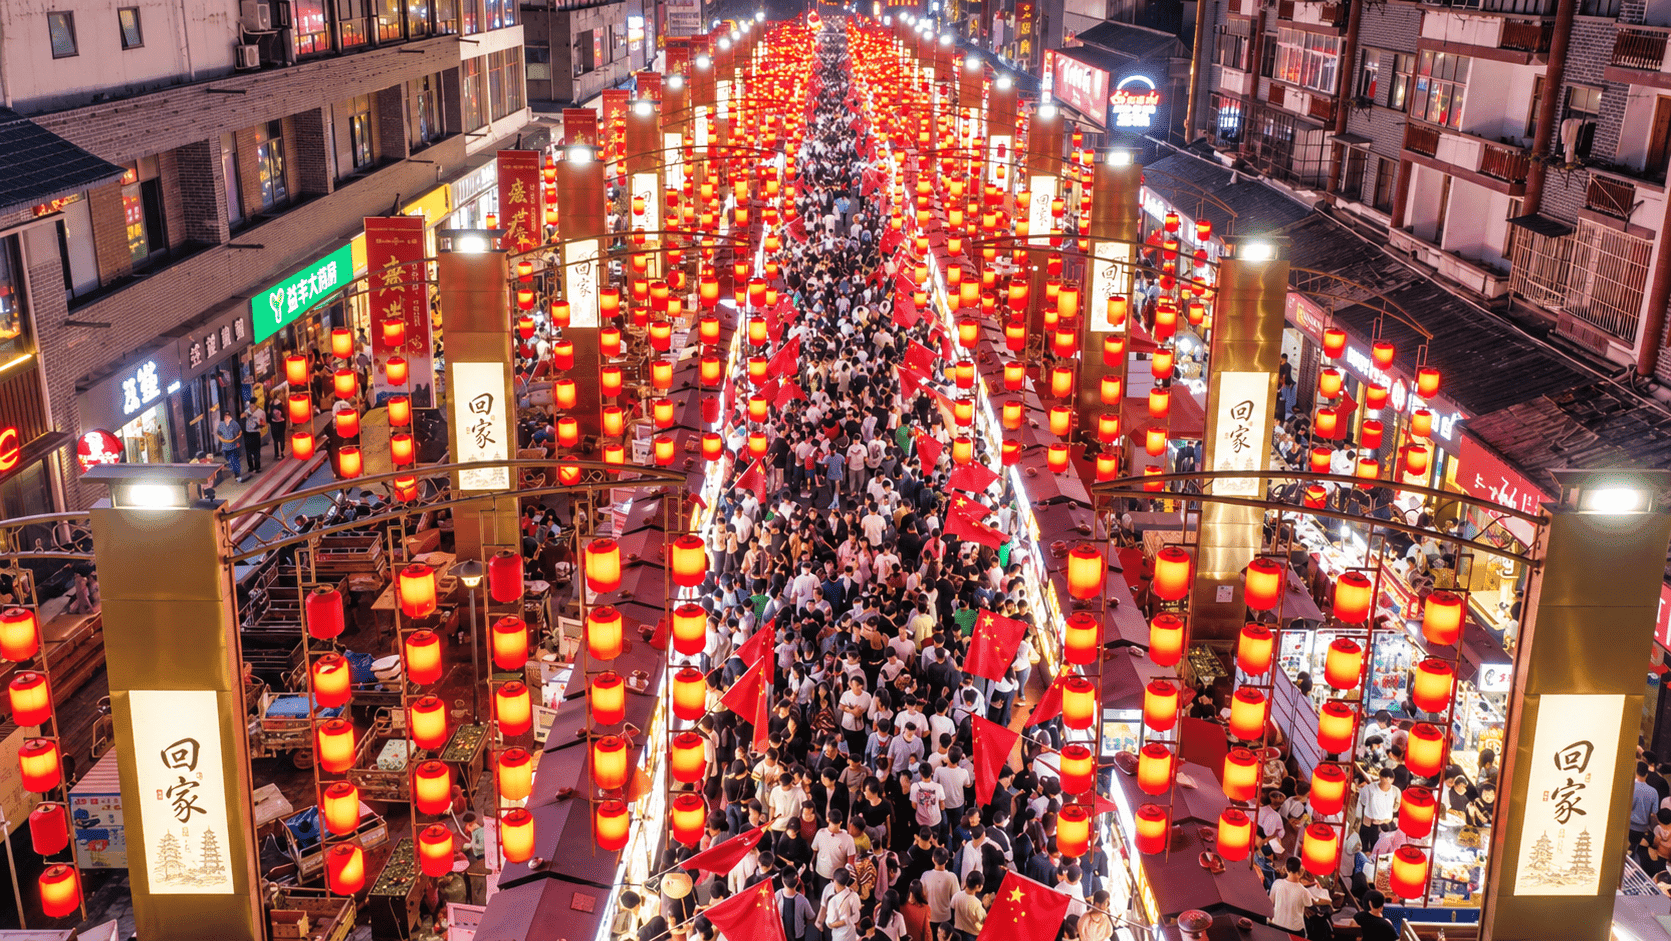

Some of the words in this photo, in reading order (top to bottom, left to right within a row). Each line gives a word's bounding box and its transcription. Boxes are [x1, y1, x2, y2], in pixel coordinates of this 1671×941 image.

[574, 259, 592, 297] 回家
[468, 392, 496, 449] 回家
[1230, 399, 1255, 454] 回家
[160, 737, 207, 824] 回家
[1550, 740, 1595, 825] 回家
